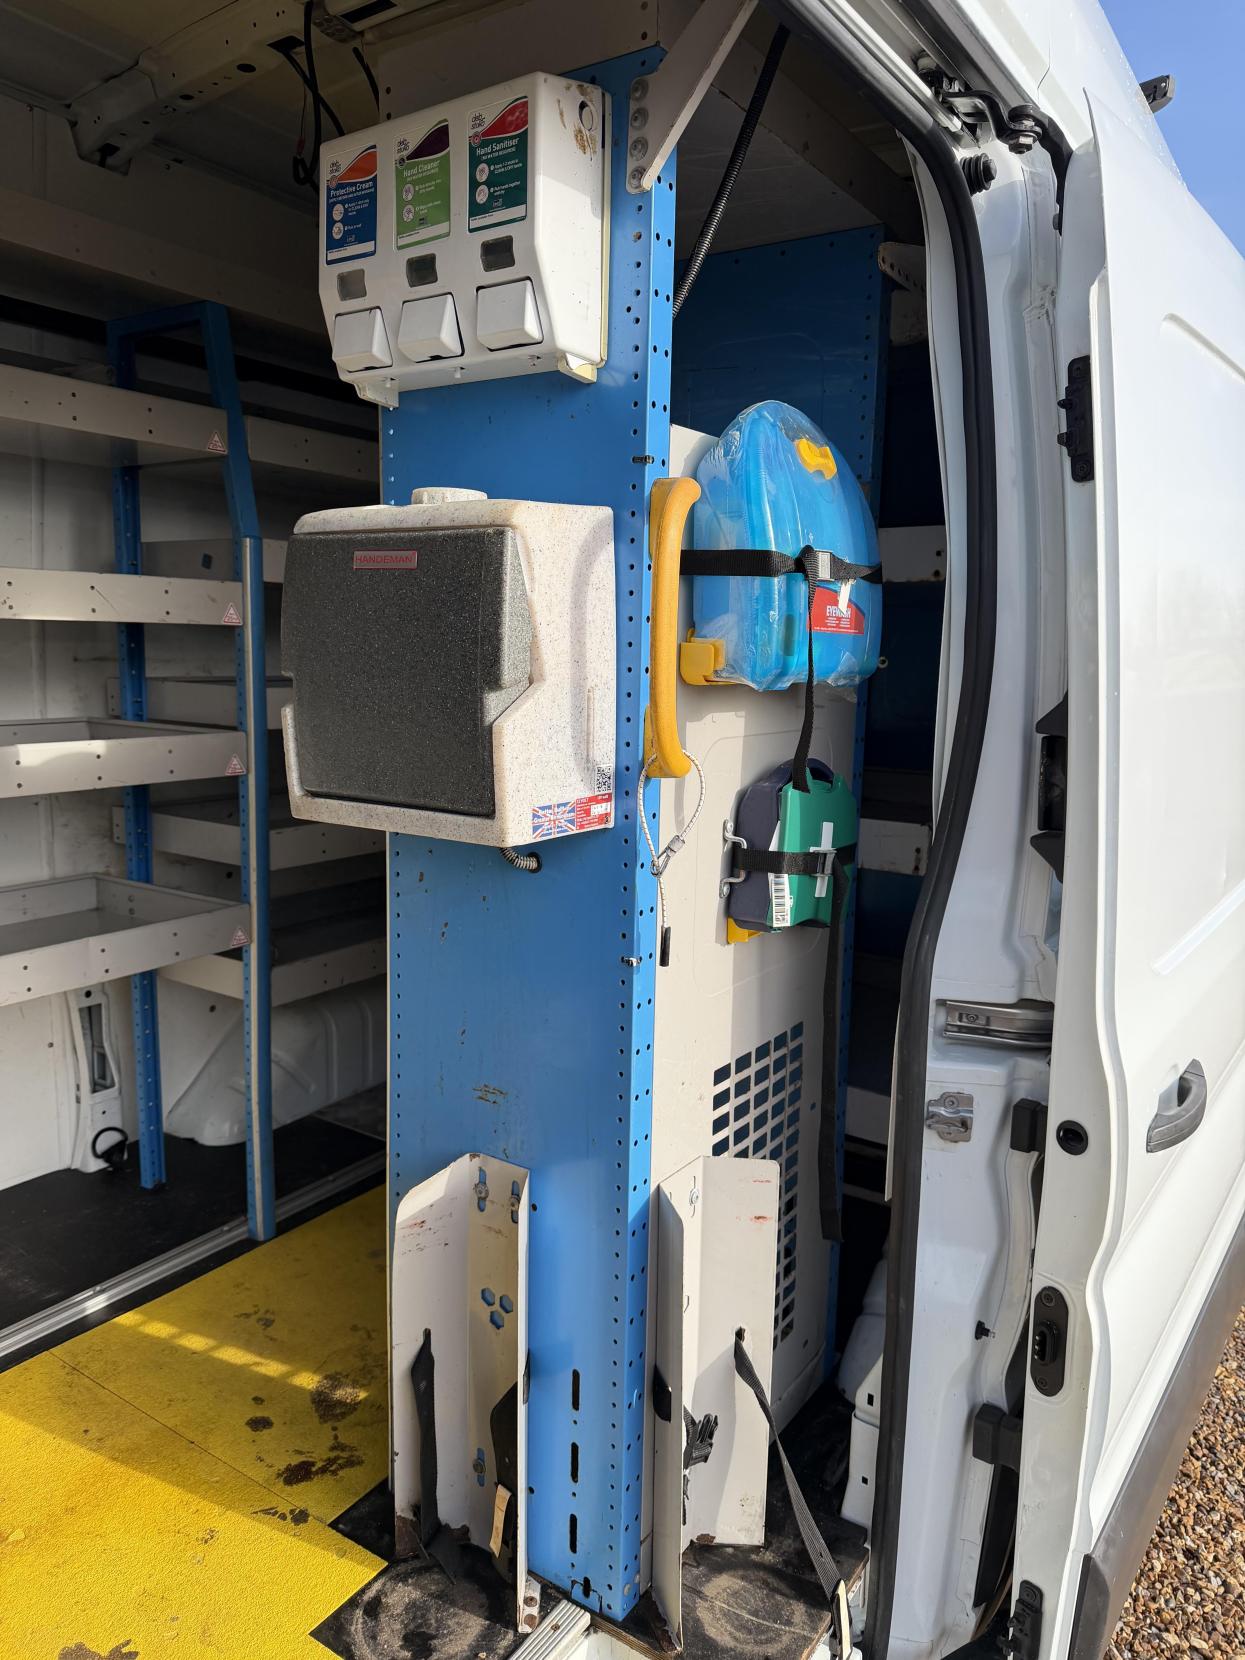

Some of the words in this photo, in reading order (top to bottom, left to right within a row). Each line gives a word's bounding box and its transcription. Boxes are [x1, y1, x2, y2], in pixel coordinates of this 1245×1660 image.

[476, 144, 492, 156] Hand
[492, 137, 520, 151] Sanitiser
[403, 167, 418, 177] Hand
[418, 160, 441, 172] Cleaner
[330, 187, 356, 197] Protective
[356, 181, 374, 190] Cream
[355, 554, 412, 564] HANDEMAN
